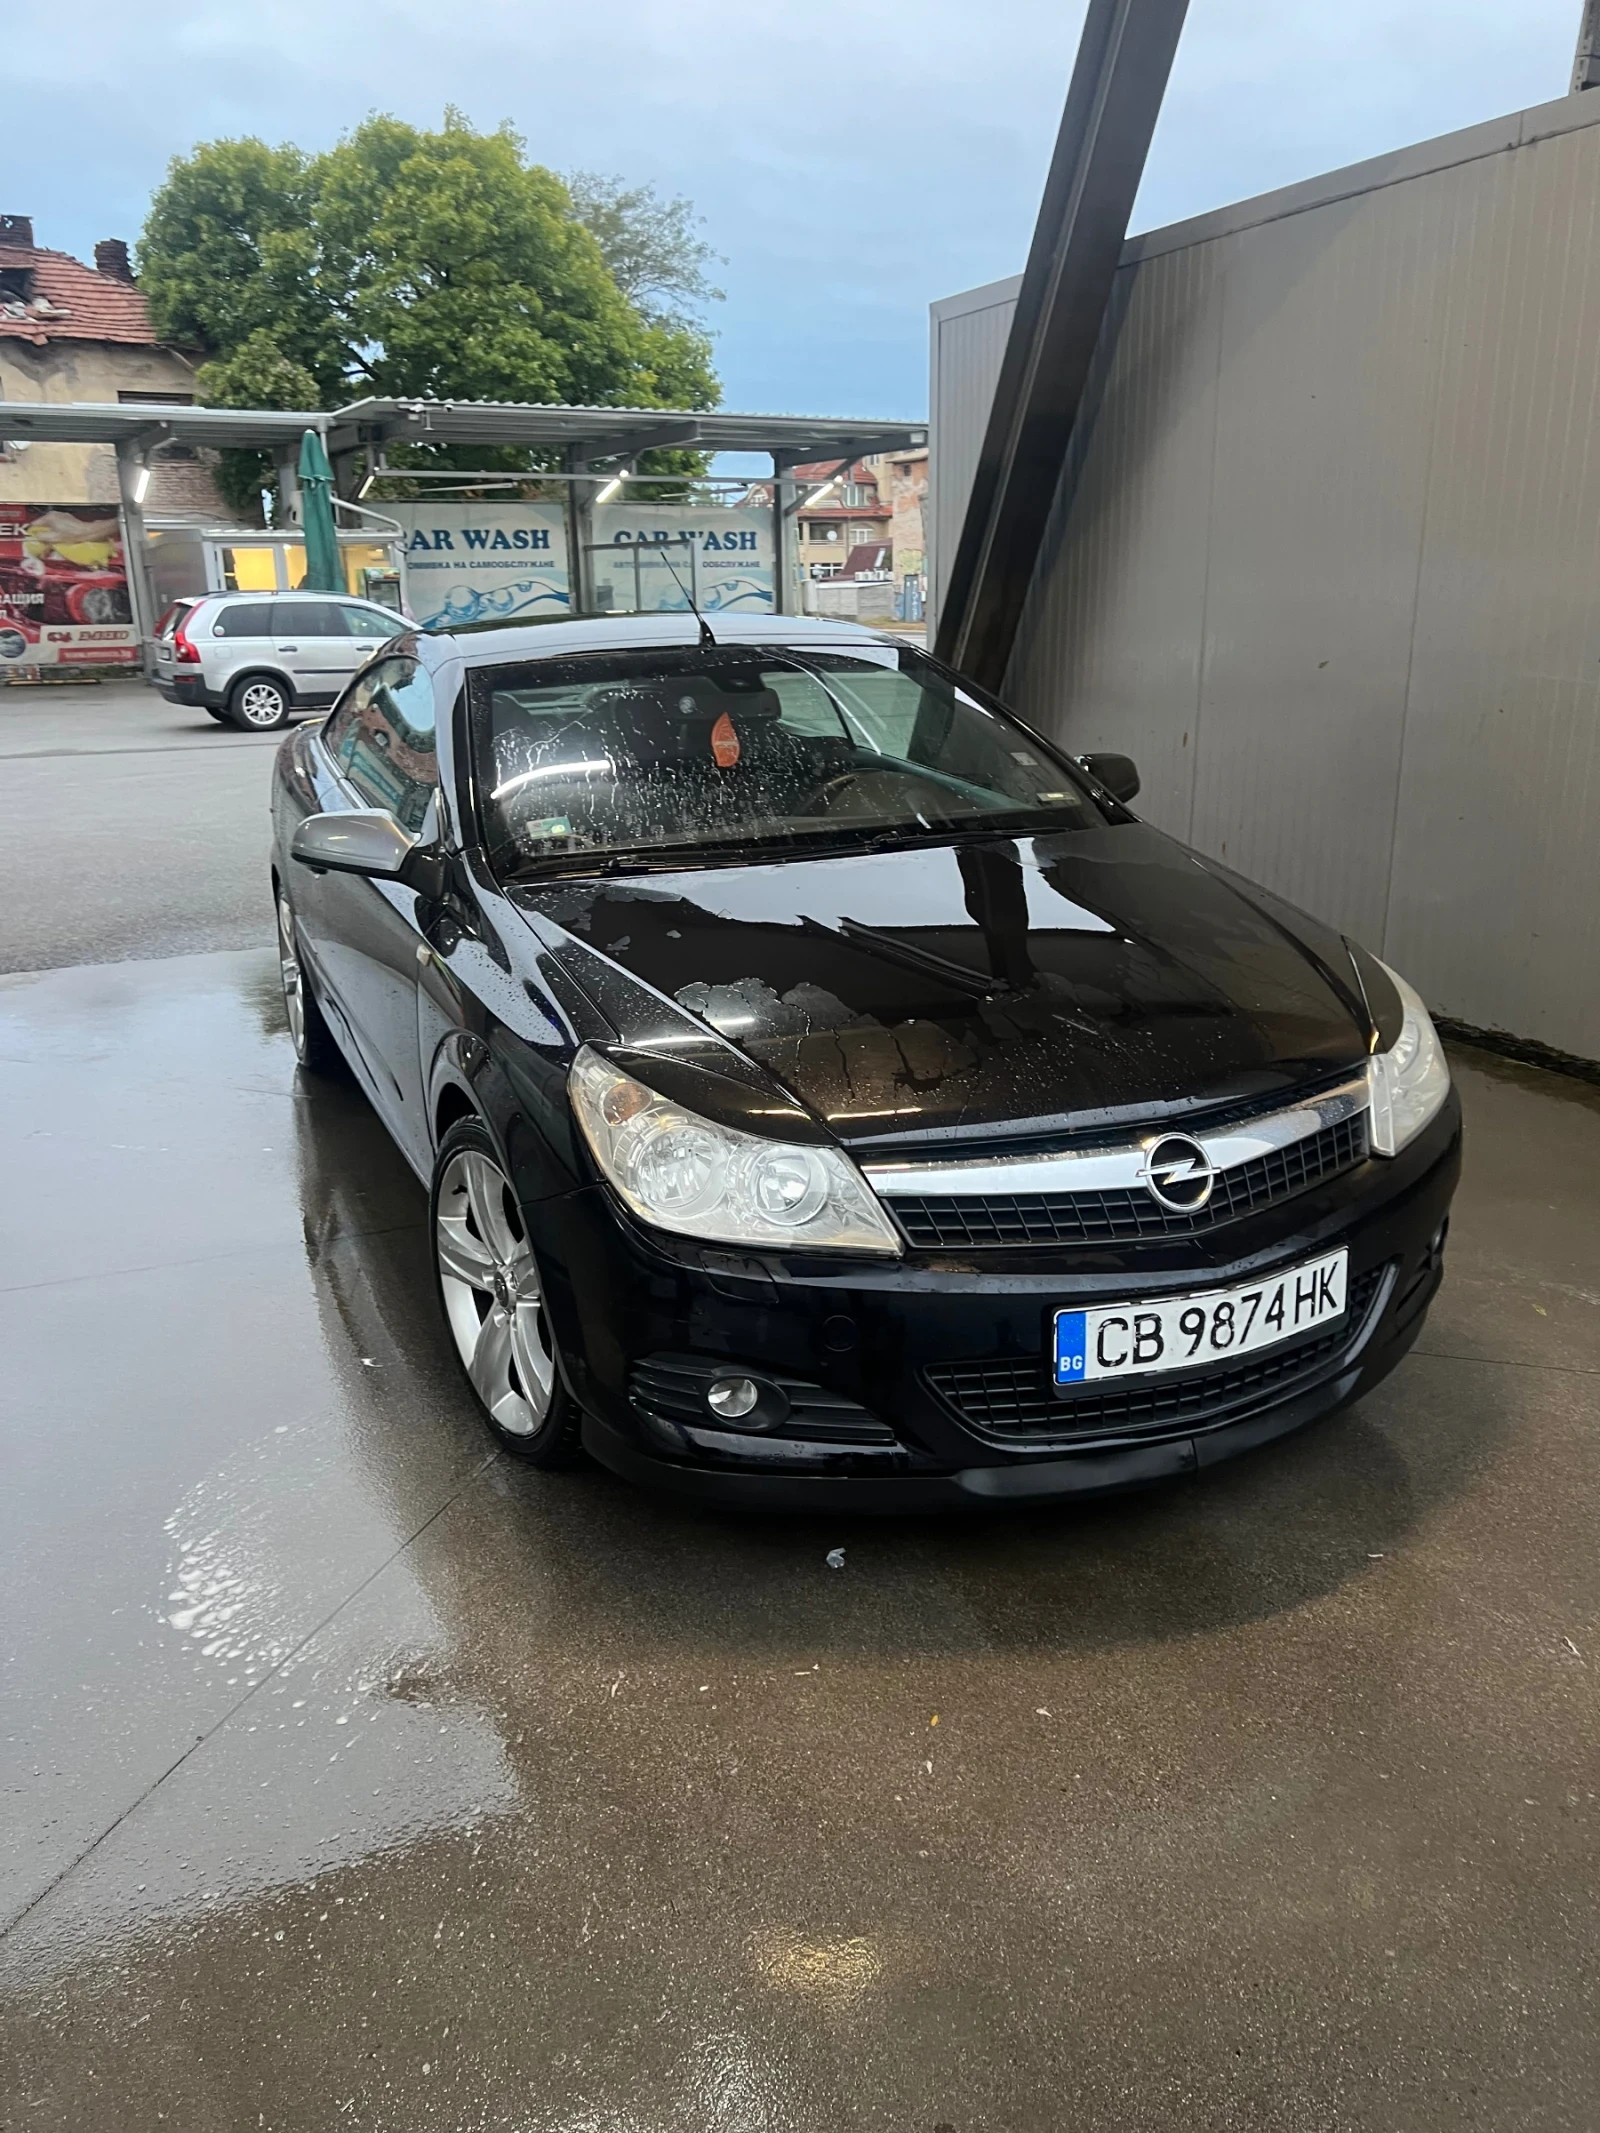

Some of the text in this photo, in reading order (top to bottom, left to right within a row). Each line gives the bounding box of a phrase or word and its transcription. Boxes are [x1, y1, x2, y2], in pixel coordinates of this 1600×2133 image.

[461, 529, 550, 549] WASH
[614, 530, 671, 550] CAR
[408, 561, 451, 570] ОМИВКА
[453, 561, 467, 569] НА
[1096, 1260, 1339, 1368] CB 9874 HK
[1060, 1355, 1083, 1372] BG
